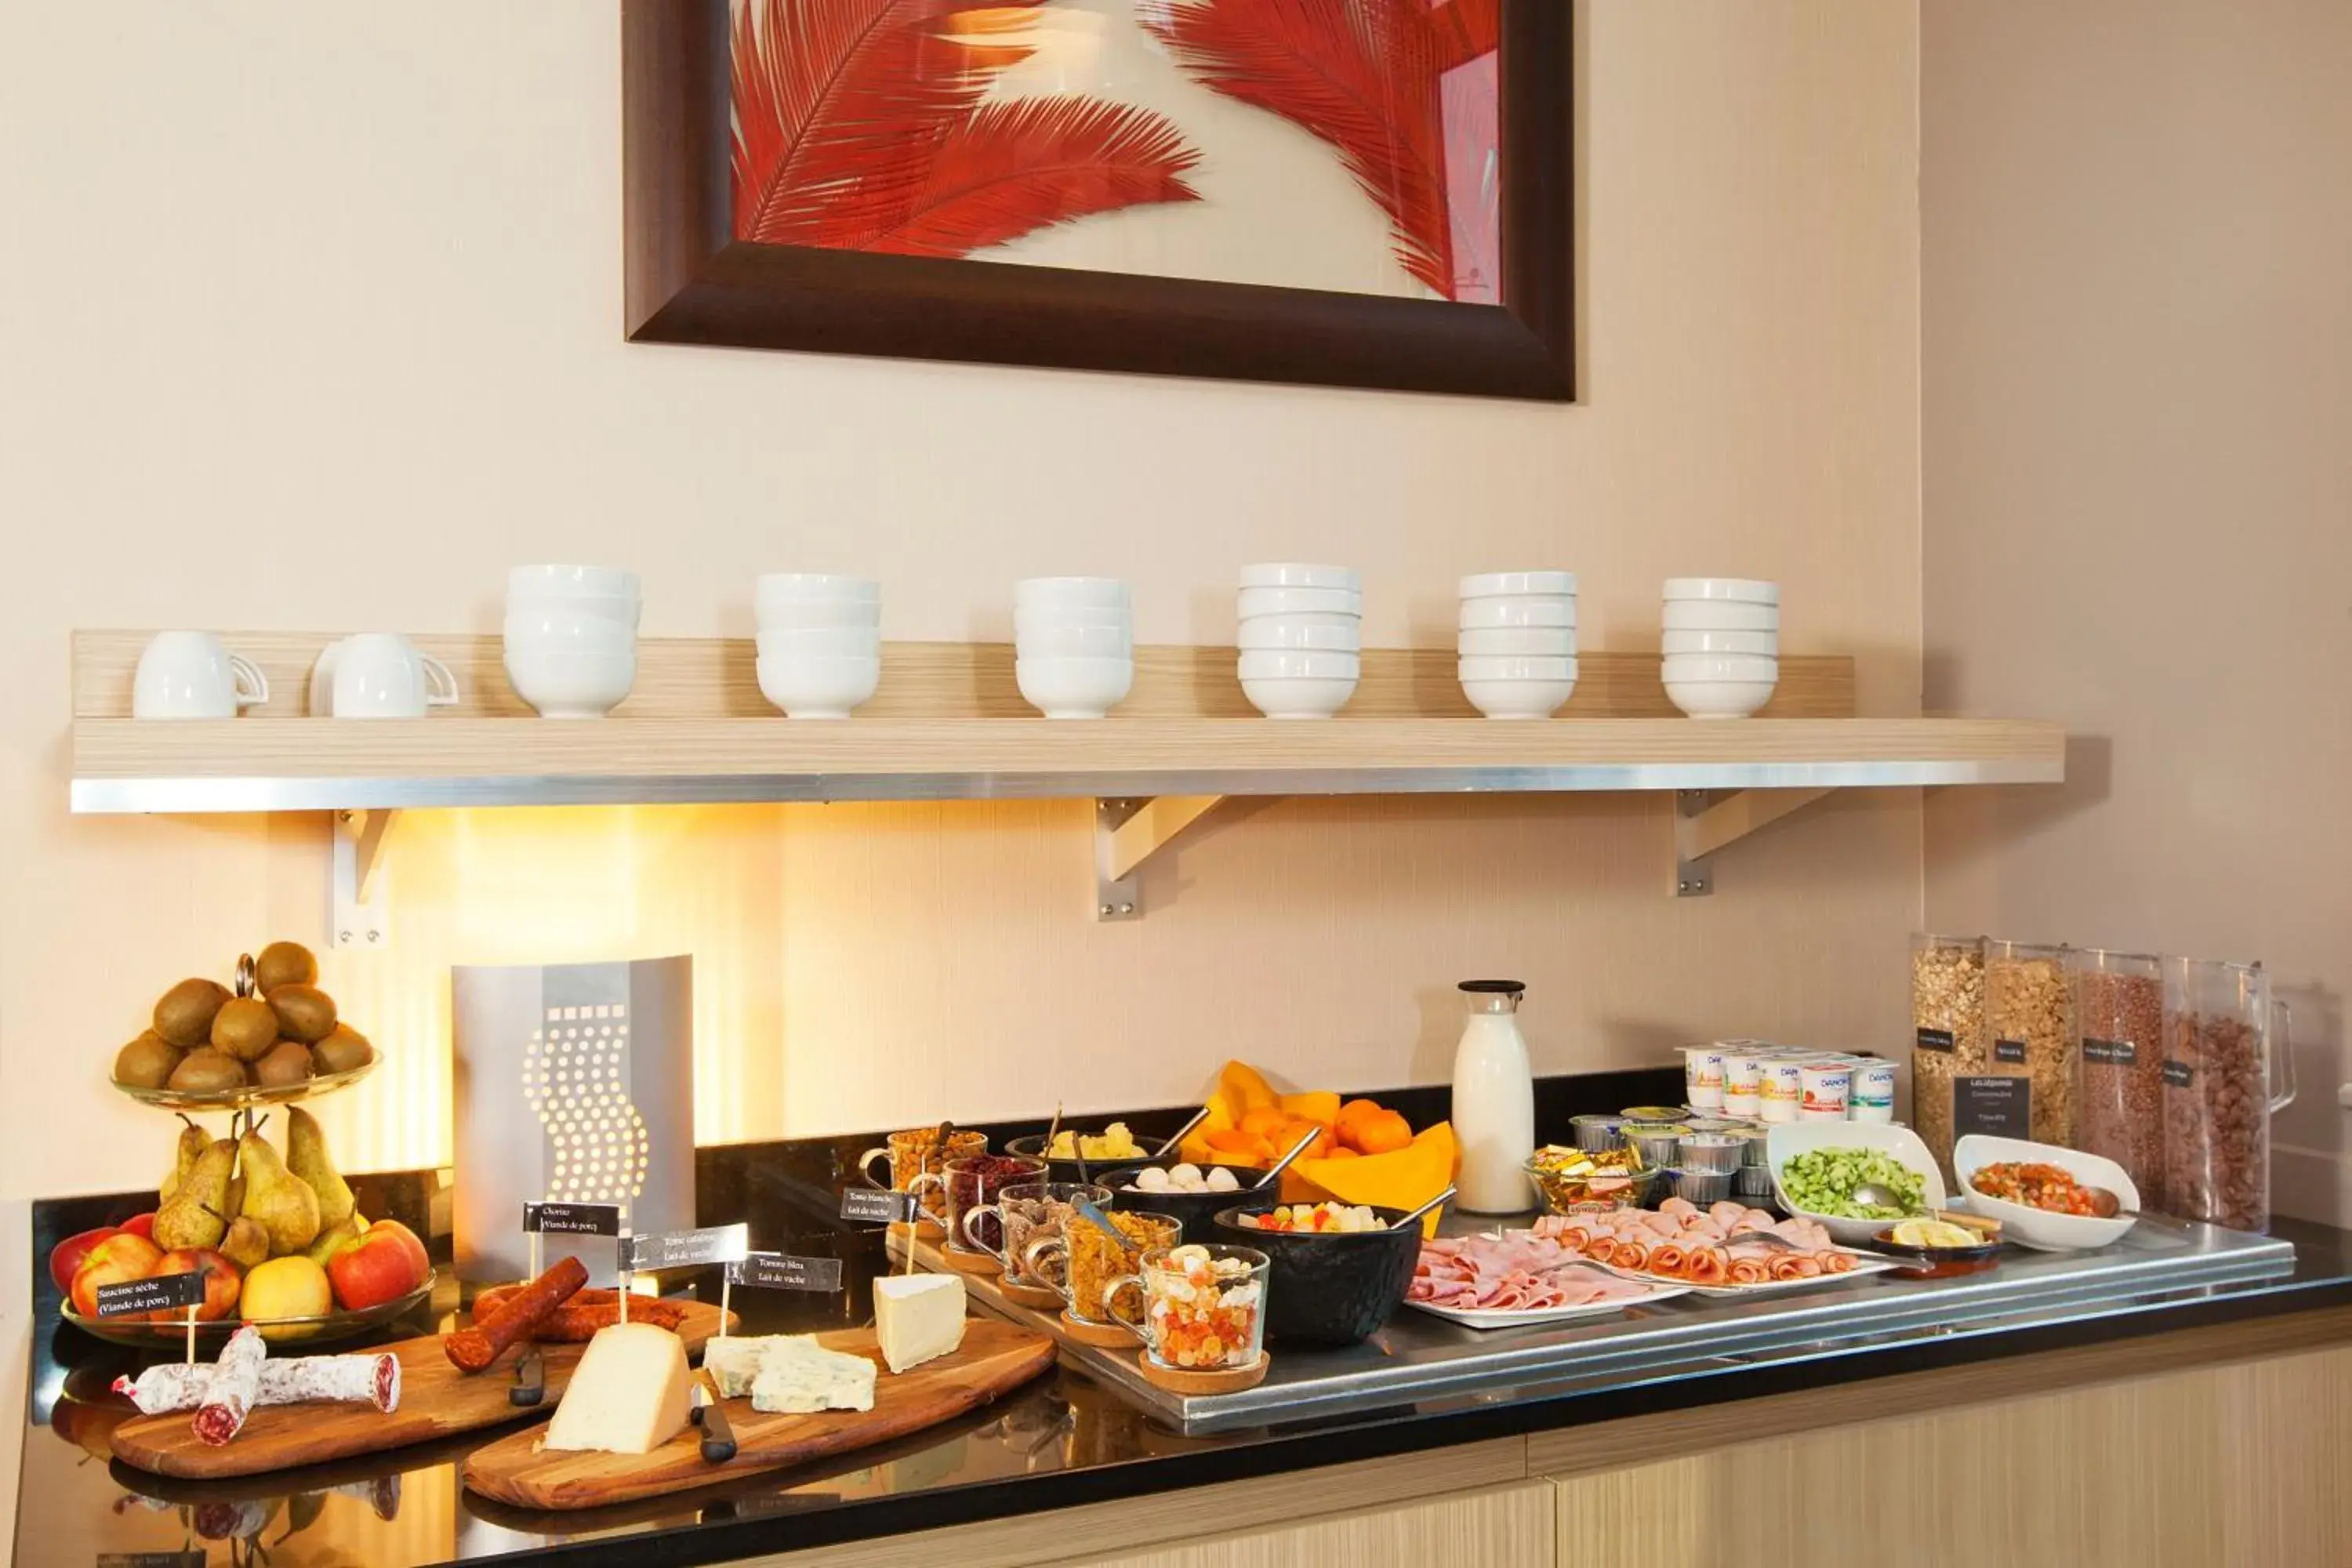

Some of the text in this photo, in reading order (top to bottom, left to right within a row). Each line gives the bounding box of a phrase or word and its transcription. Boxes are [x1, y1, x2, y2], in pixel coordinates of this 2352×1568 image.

[568, 1221, 579, 1229] de
[758, 1272, 807, 1285] Lait de vache
[99, 1295, 171, 1316] (Viande de porc)
